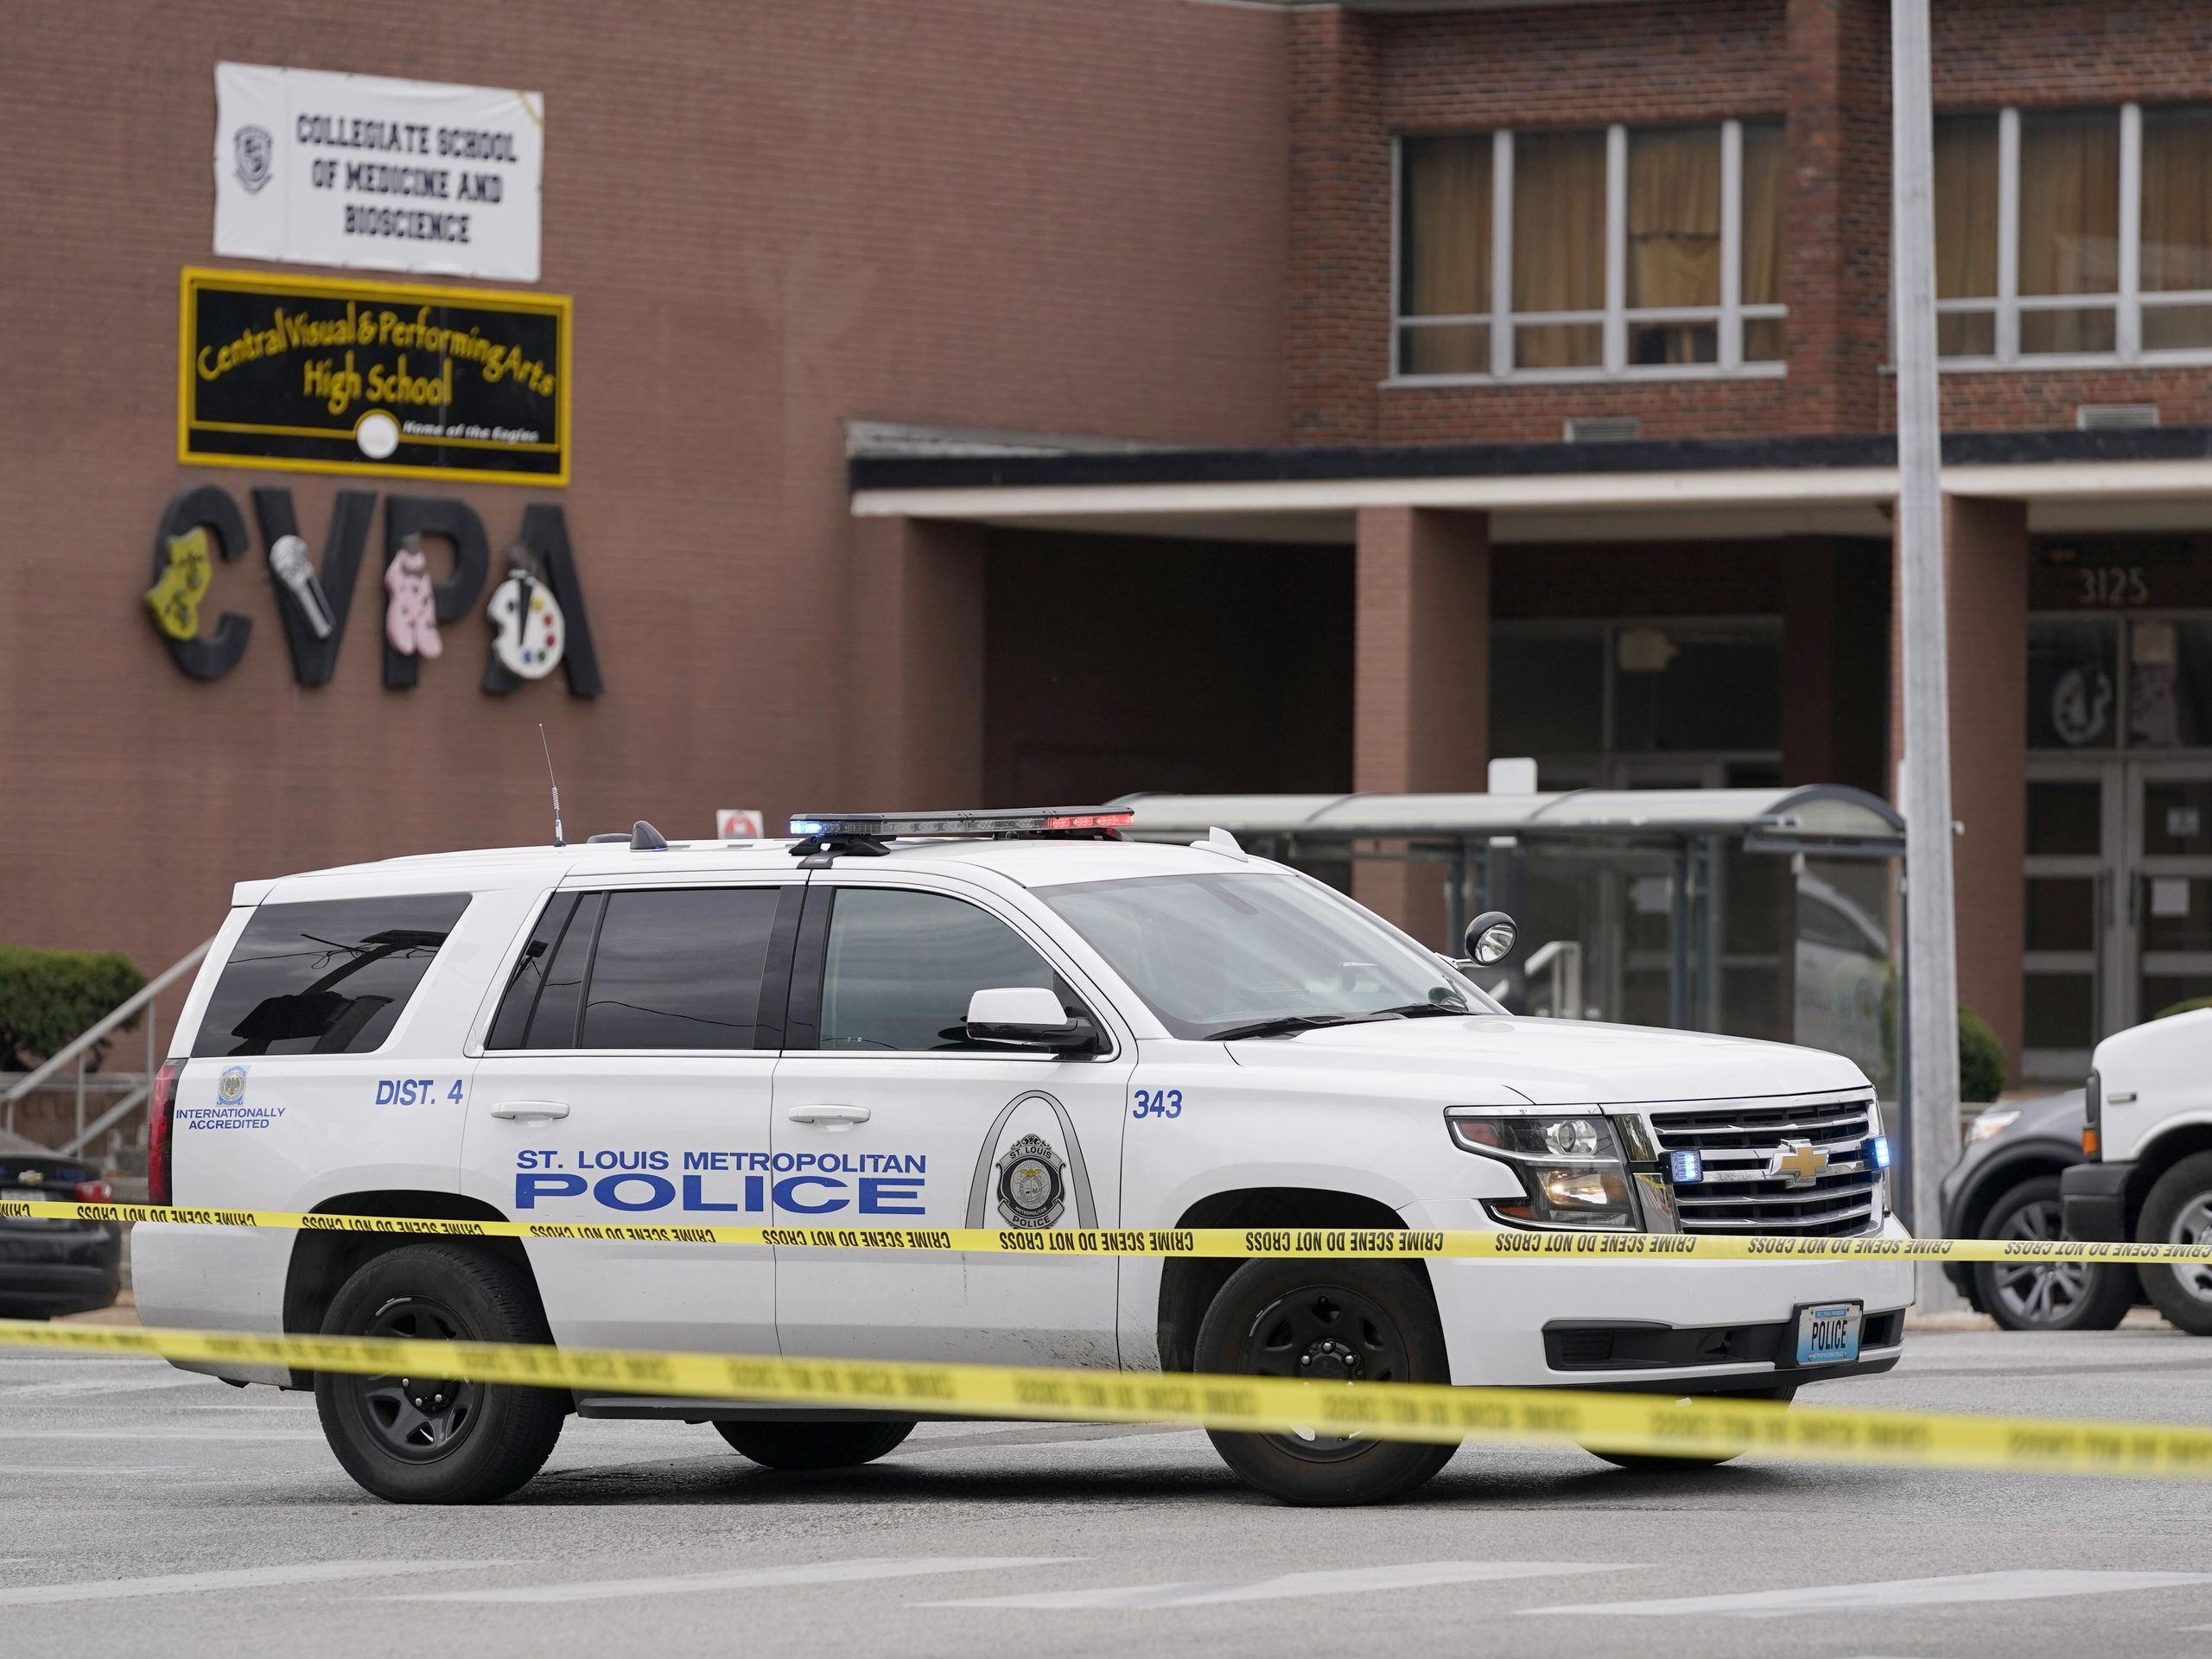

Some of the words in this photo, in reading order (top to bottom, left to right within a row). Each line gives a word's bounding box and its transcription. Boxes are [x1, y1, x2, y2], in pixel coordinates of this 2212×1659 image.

[296, 113, 430, 155] COLLEGIATE
[436, 127, 518, 162] SCHOOL
[312, 159, 339, 189] OF
[346, 162, 449, 200] MEDICINE
[456, 171, 503, 203] AND
[344, 204, 471, 245] BIOSCIENCE
[197, 307, 288, 381] Central
[284, 299, 356, 349] Visual
[357, 309, 378, 345] &
[378, 304, 506, 383] Performing
[500, 344, 556, 397] Arts
[304, 348, 362, 415] High
[365, 353, 453, 406] School
[153, 485, 602, 698] CVPA
[2078, 567, 2148, 604] 3125
[375, 1079, 435, 1105] DIST.
[447, 1079, 464, 1105] 4
[175, 1107, 286, 1119] INTERNATIONALLY
[1132, 1090, 1182, 1119] 343
[188, 1119, 270, 1130] ACCREDITED
[516, 1150, 564, 1170] ST.
[578, 1150, 670, 1171] LOUIS
[683, 1151, 927, 1173] METROPOLITAN
[1009, 1148, 1023, 1159] ST.
[1025, 1146, 1052, 1159] LOUIS
[515, 1173, 926, 1216] POLICE
[1012, 1215, 1051, 1228] POLICE
[762, 1230, 806, 1244] CROSS
[811, 1231, 836, 1246] NOT
[840, 1231, 856, 1246] DO
[861, 1231, 904, 1248] SCENE
[907, 1232, 950, 1249] CRIME
[999, 1232, 1043, 1251] CROSS
[1049, 1232, 1074, 1251] NOT
[1078, 1233, 1096, 1251] DO
[1102, 1232, 1145, 1252] SCENE
[1149, 1232, 1193, 1252] CRIME
[1246, 1232, 1291, 1252] CROSS
[1296, 1232, 1322, 1252] NOT
[1326, 1232, 1345, 1252] DO
[1351, 1232, 1394, 1252] SCENE
[1398, 1232, 1444, 1252] CRIME
[1496, 1233, 1541, 1253] CROSS
[1545, 1235, 1573, 1253] NOT
[1577, 1235, 1596, 1253] DO
[1600, 1236, 1645, 1254] SCENE
[1649, 1236, 1697, 1254] CRIME
[1748, 1238, 1794, 1255] CROSS
[1796, 1239, 1826, 1255] NOT
[1831, 1240, 1852, 1255] DO
[1854, 1240, 1901, 1255] SCENE
[1904, 1241, 1954, 1255] CRIME
[2004, 1243, 2054, 1255] CROSS
[2056, 1243, 2086, 1256] NOT
[2088, 1244, 2110, 1256] DO
[2112, 1244, 2160, 1257] SCENE
[2163, 1245, 2212, 1259] CRIME
[1811, 1319, 1848, 1351] POLICE
